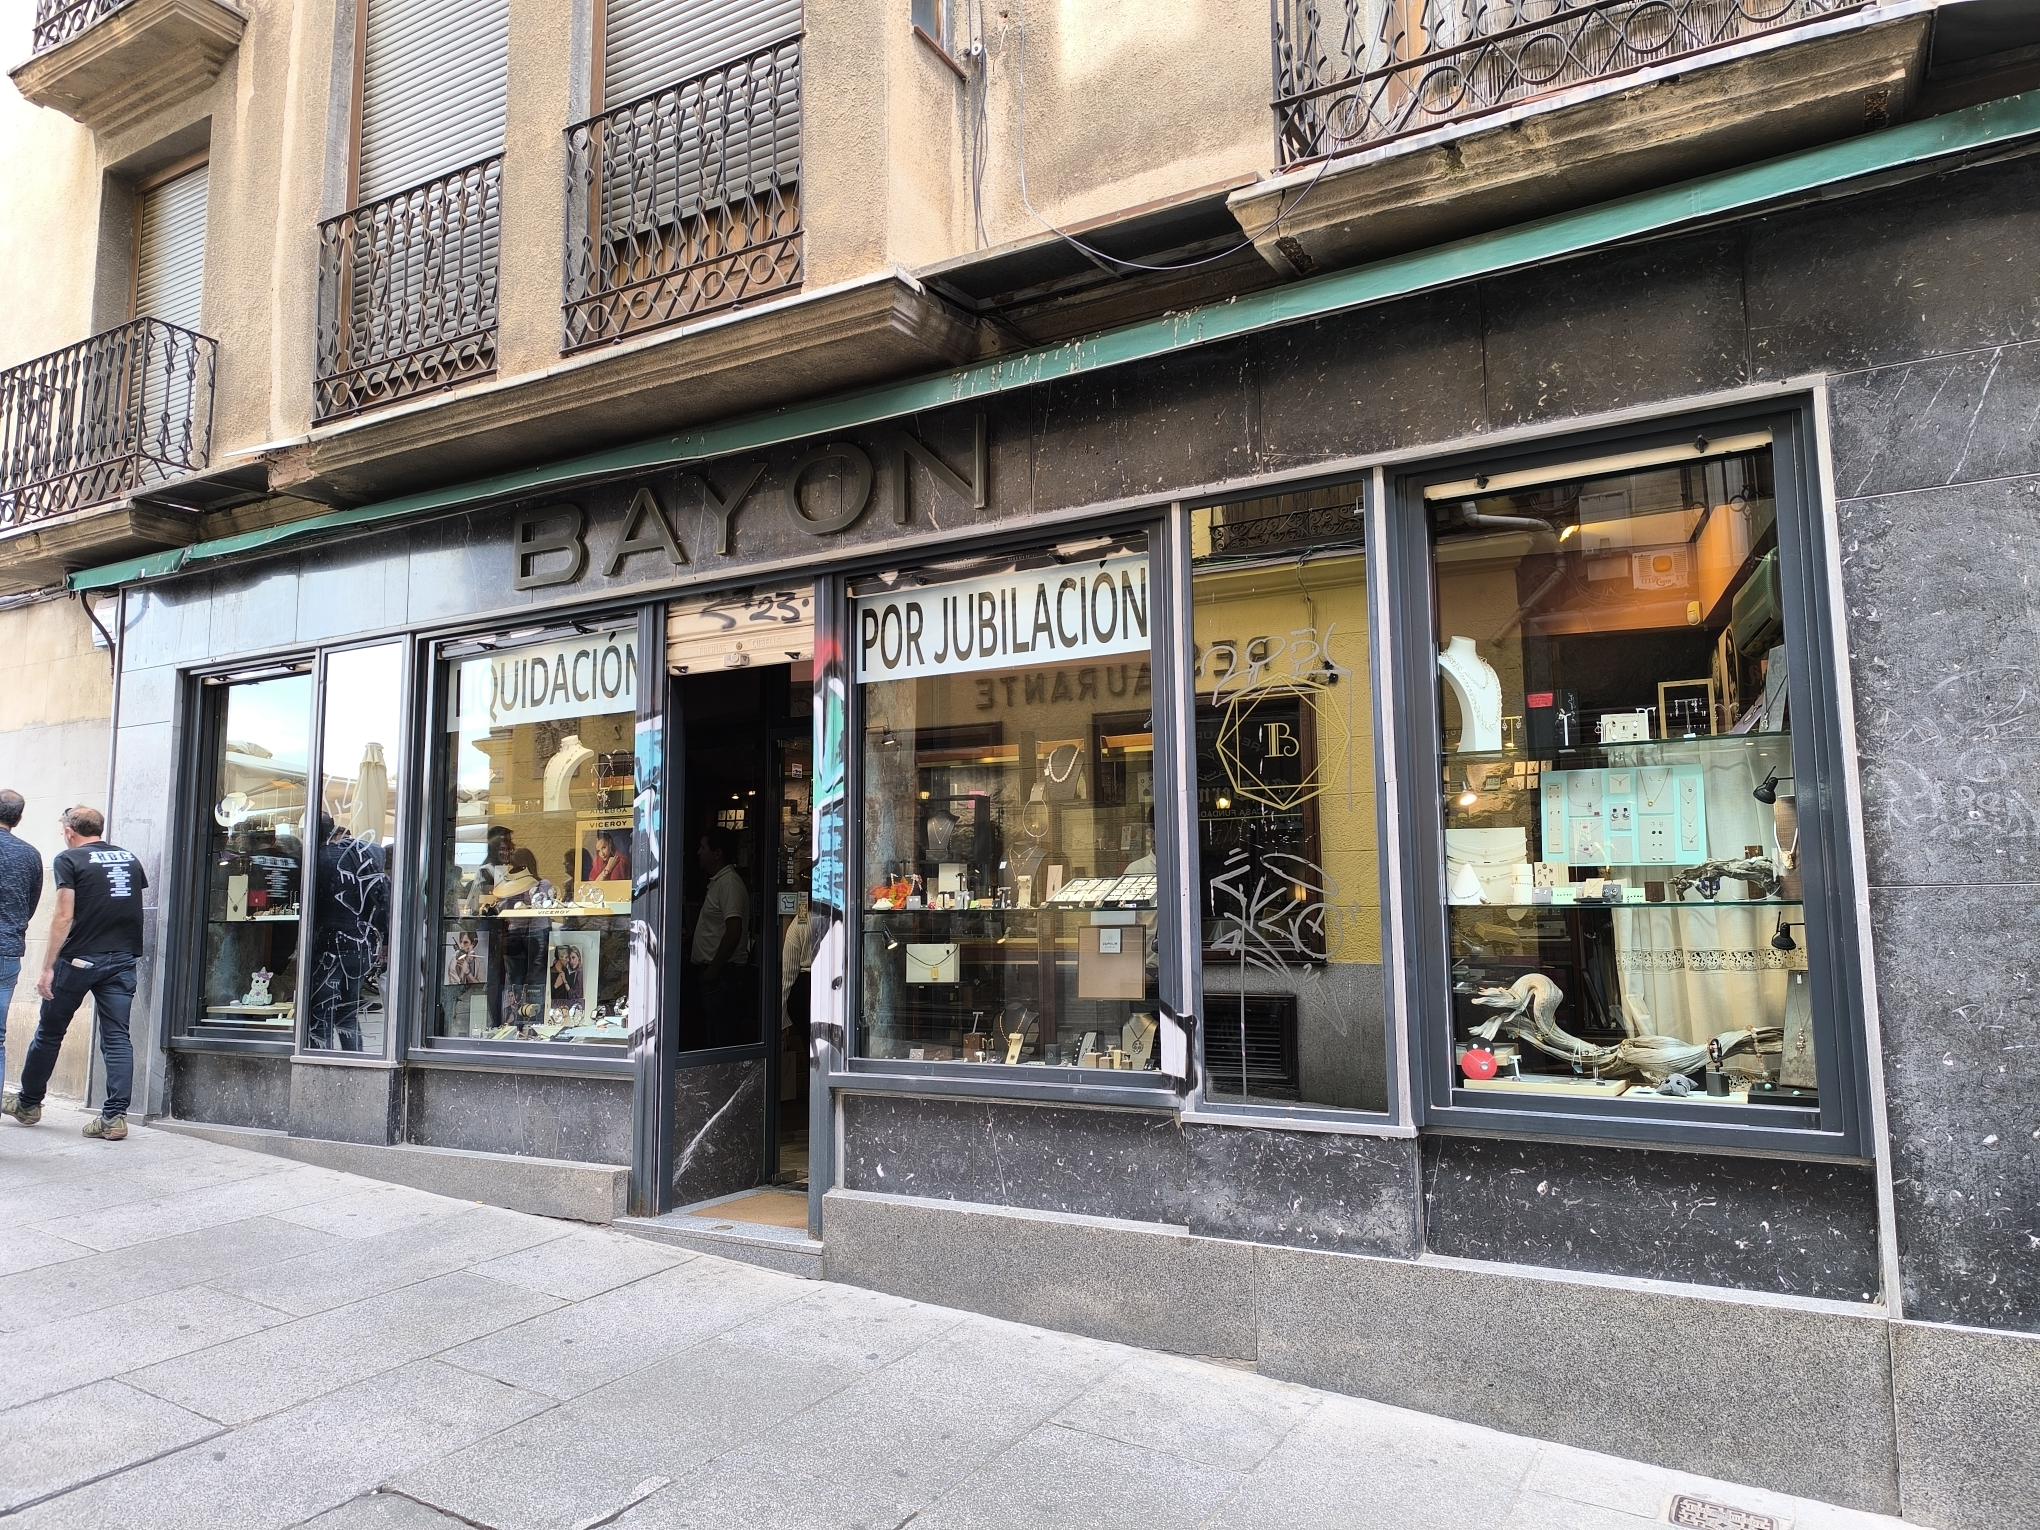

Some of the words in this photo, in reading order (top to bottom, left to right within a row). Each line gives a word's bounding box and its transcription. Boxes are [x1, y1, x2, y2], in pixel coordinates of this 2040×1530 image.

[513, 411, 988, 591] BAYON
[861, 601, 925, 671] POR
[933, 560, 1148, 664] JUBILACIÓN
[455, 631, 638, 722] LQUIDACIÓN
[589, 820, 628, 828] VICEROY
